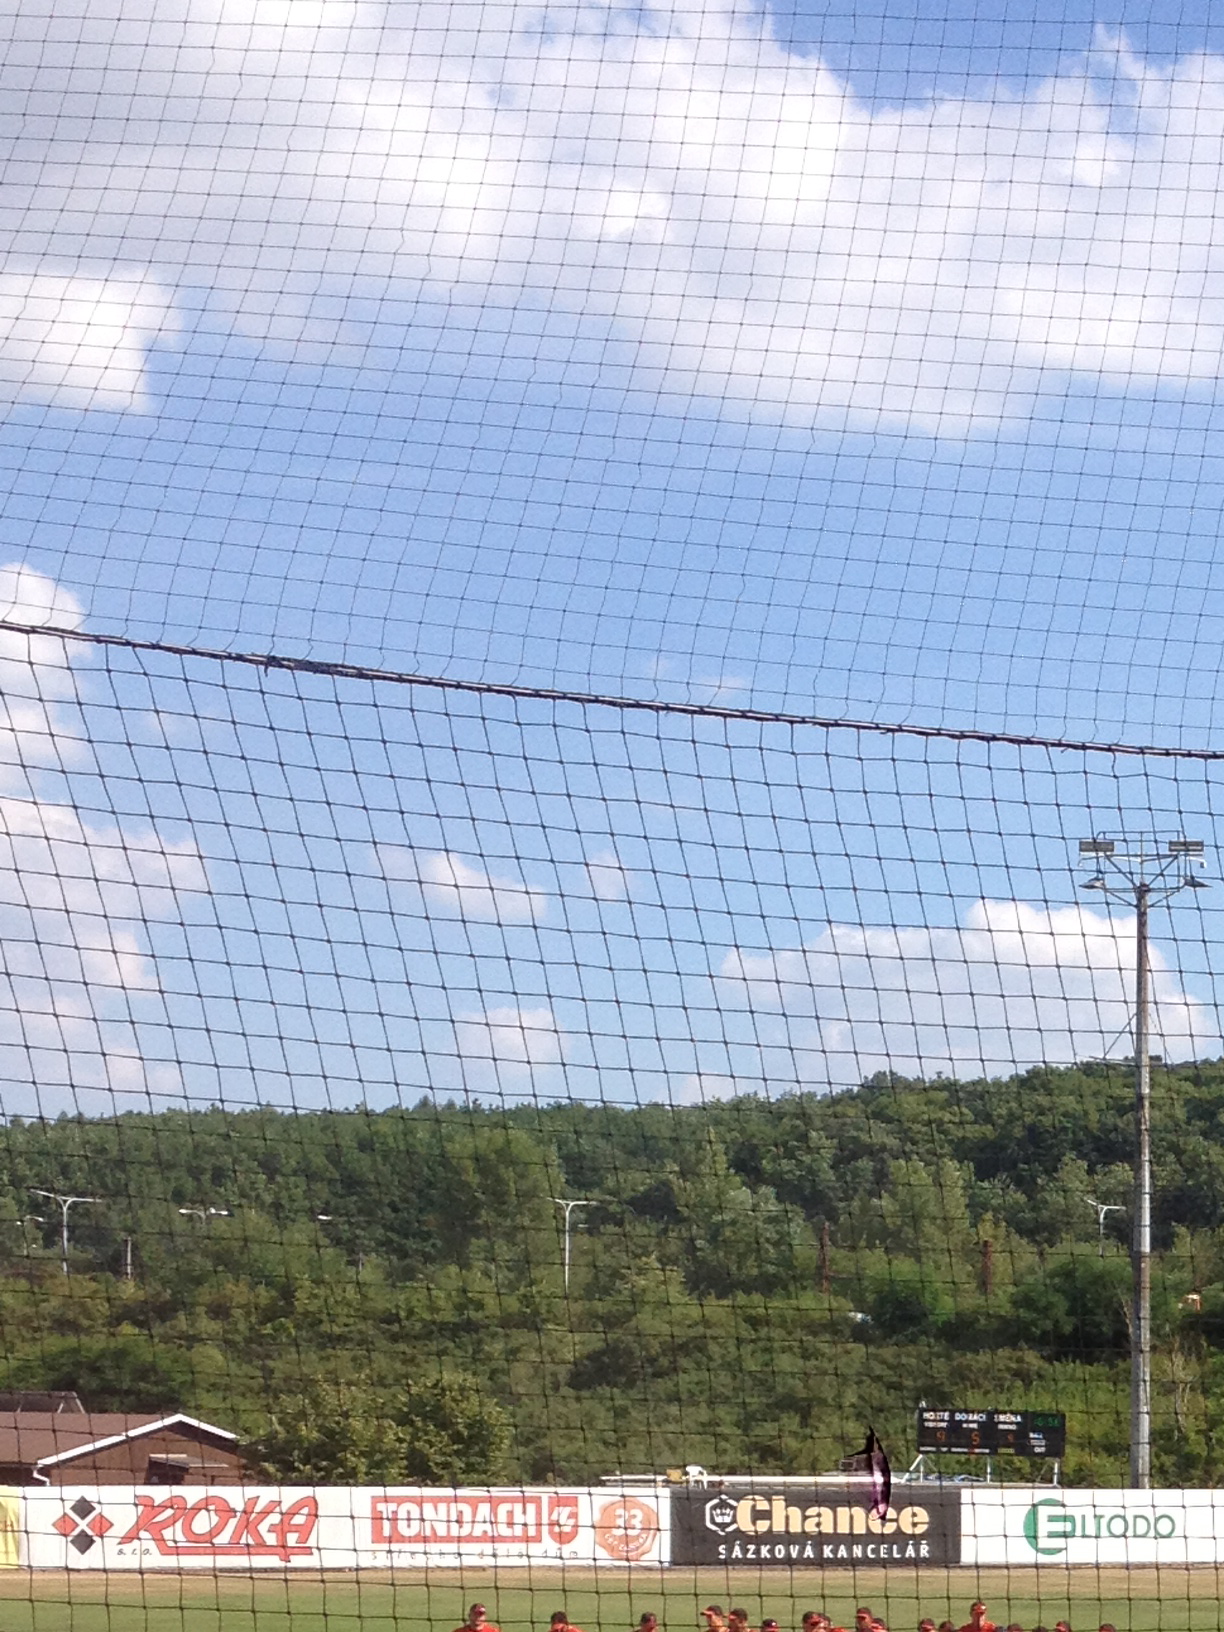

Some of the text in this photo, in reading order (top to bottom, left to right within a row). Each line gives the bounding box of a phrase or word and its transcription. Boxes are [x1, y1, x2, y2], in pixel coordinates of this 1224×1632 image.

[117, 1495, 319, 1561] ROKA
[376, 1502, 537, 1537] TONDACH
[612, 1508, 643, 1536] 33
[736, 1495, 929, 1535] Chance
[718, 1540, 930, 1559] SÁZKOVÁ KANCELÁŘ
